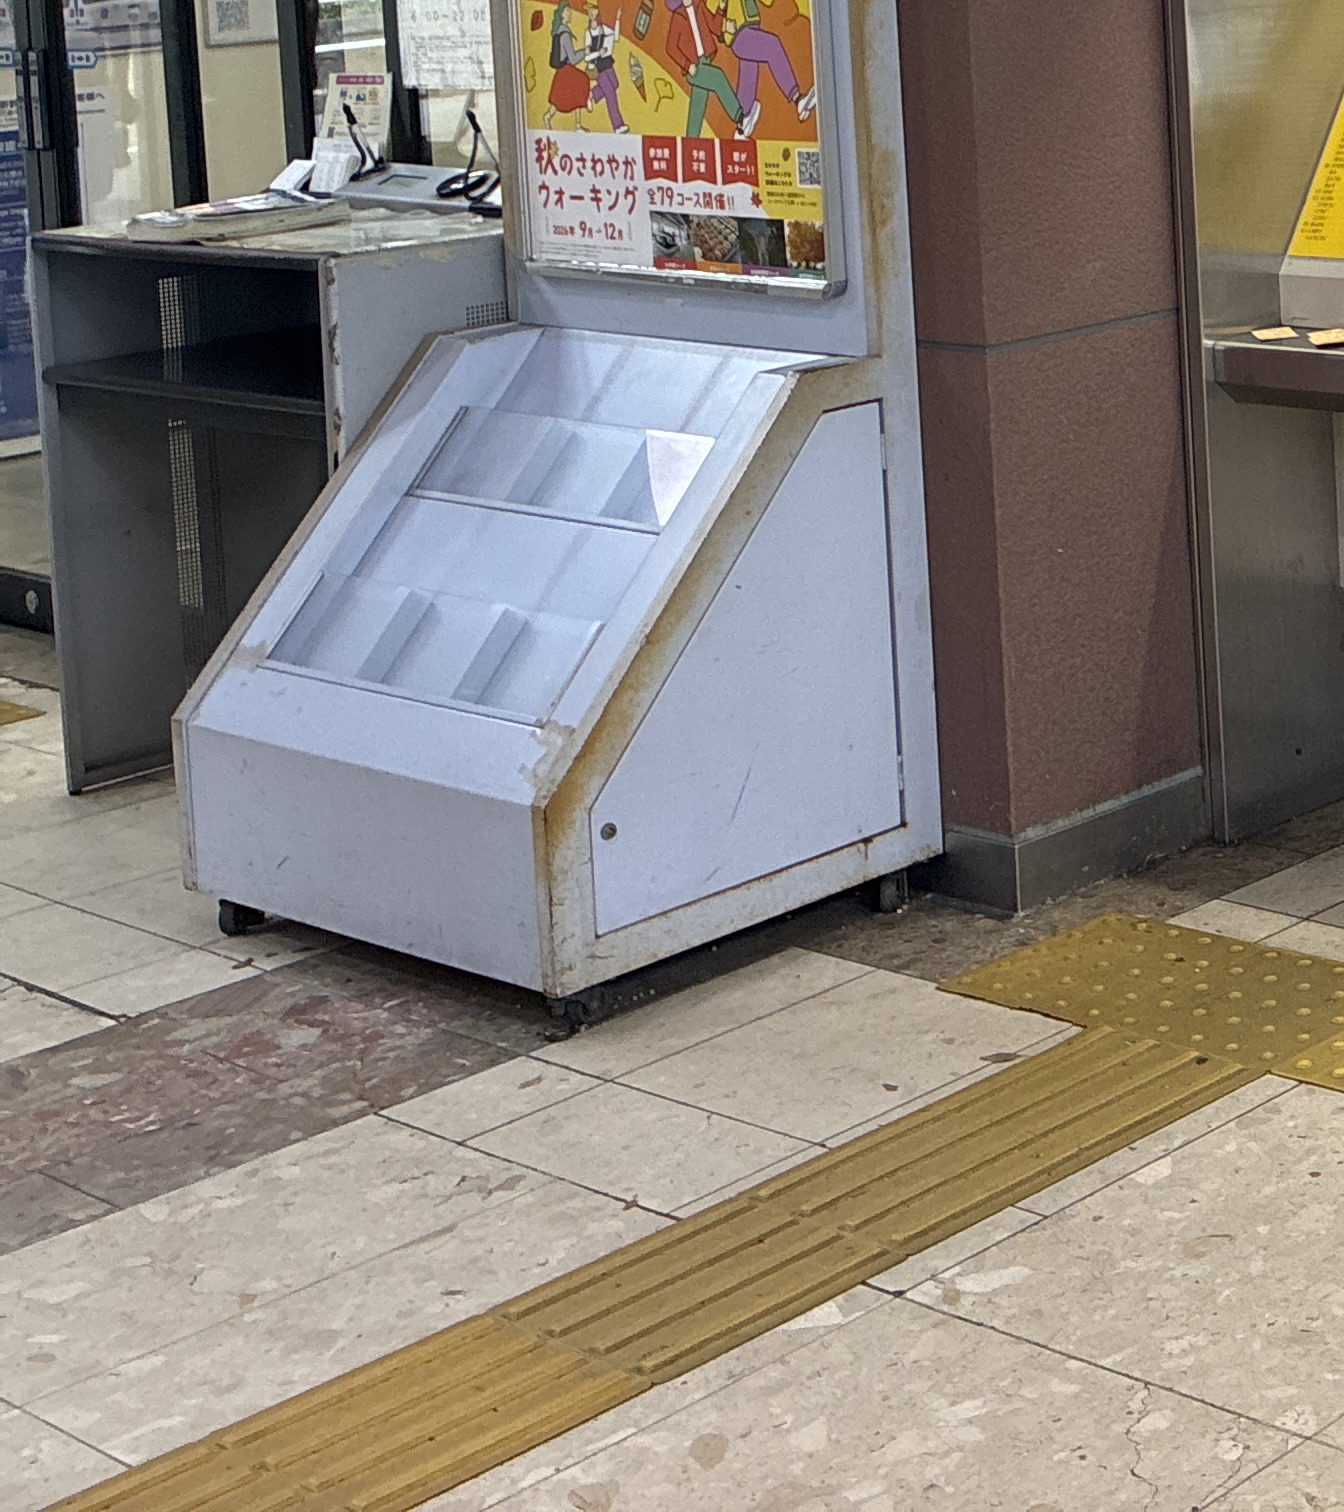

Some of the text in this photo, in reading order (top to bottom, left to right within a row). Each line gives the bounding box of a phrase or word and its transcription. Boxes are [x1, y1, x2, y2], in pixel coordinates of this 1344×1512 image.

[534, 136, 637, 181] 秋のさわやか
[538, 184, 638, 215] ウォーキング
